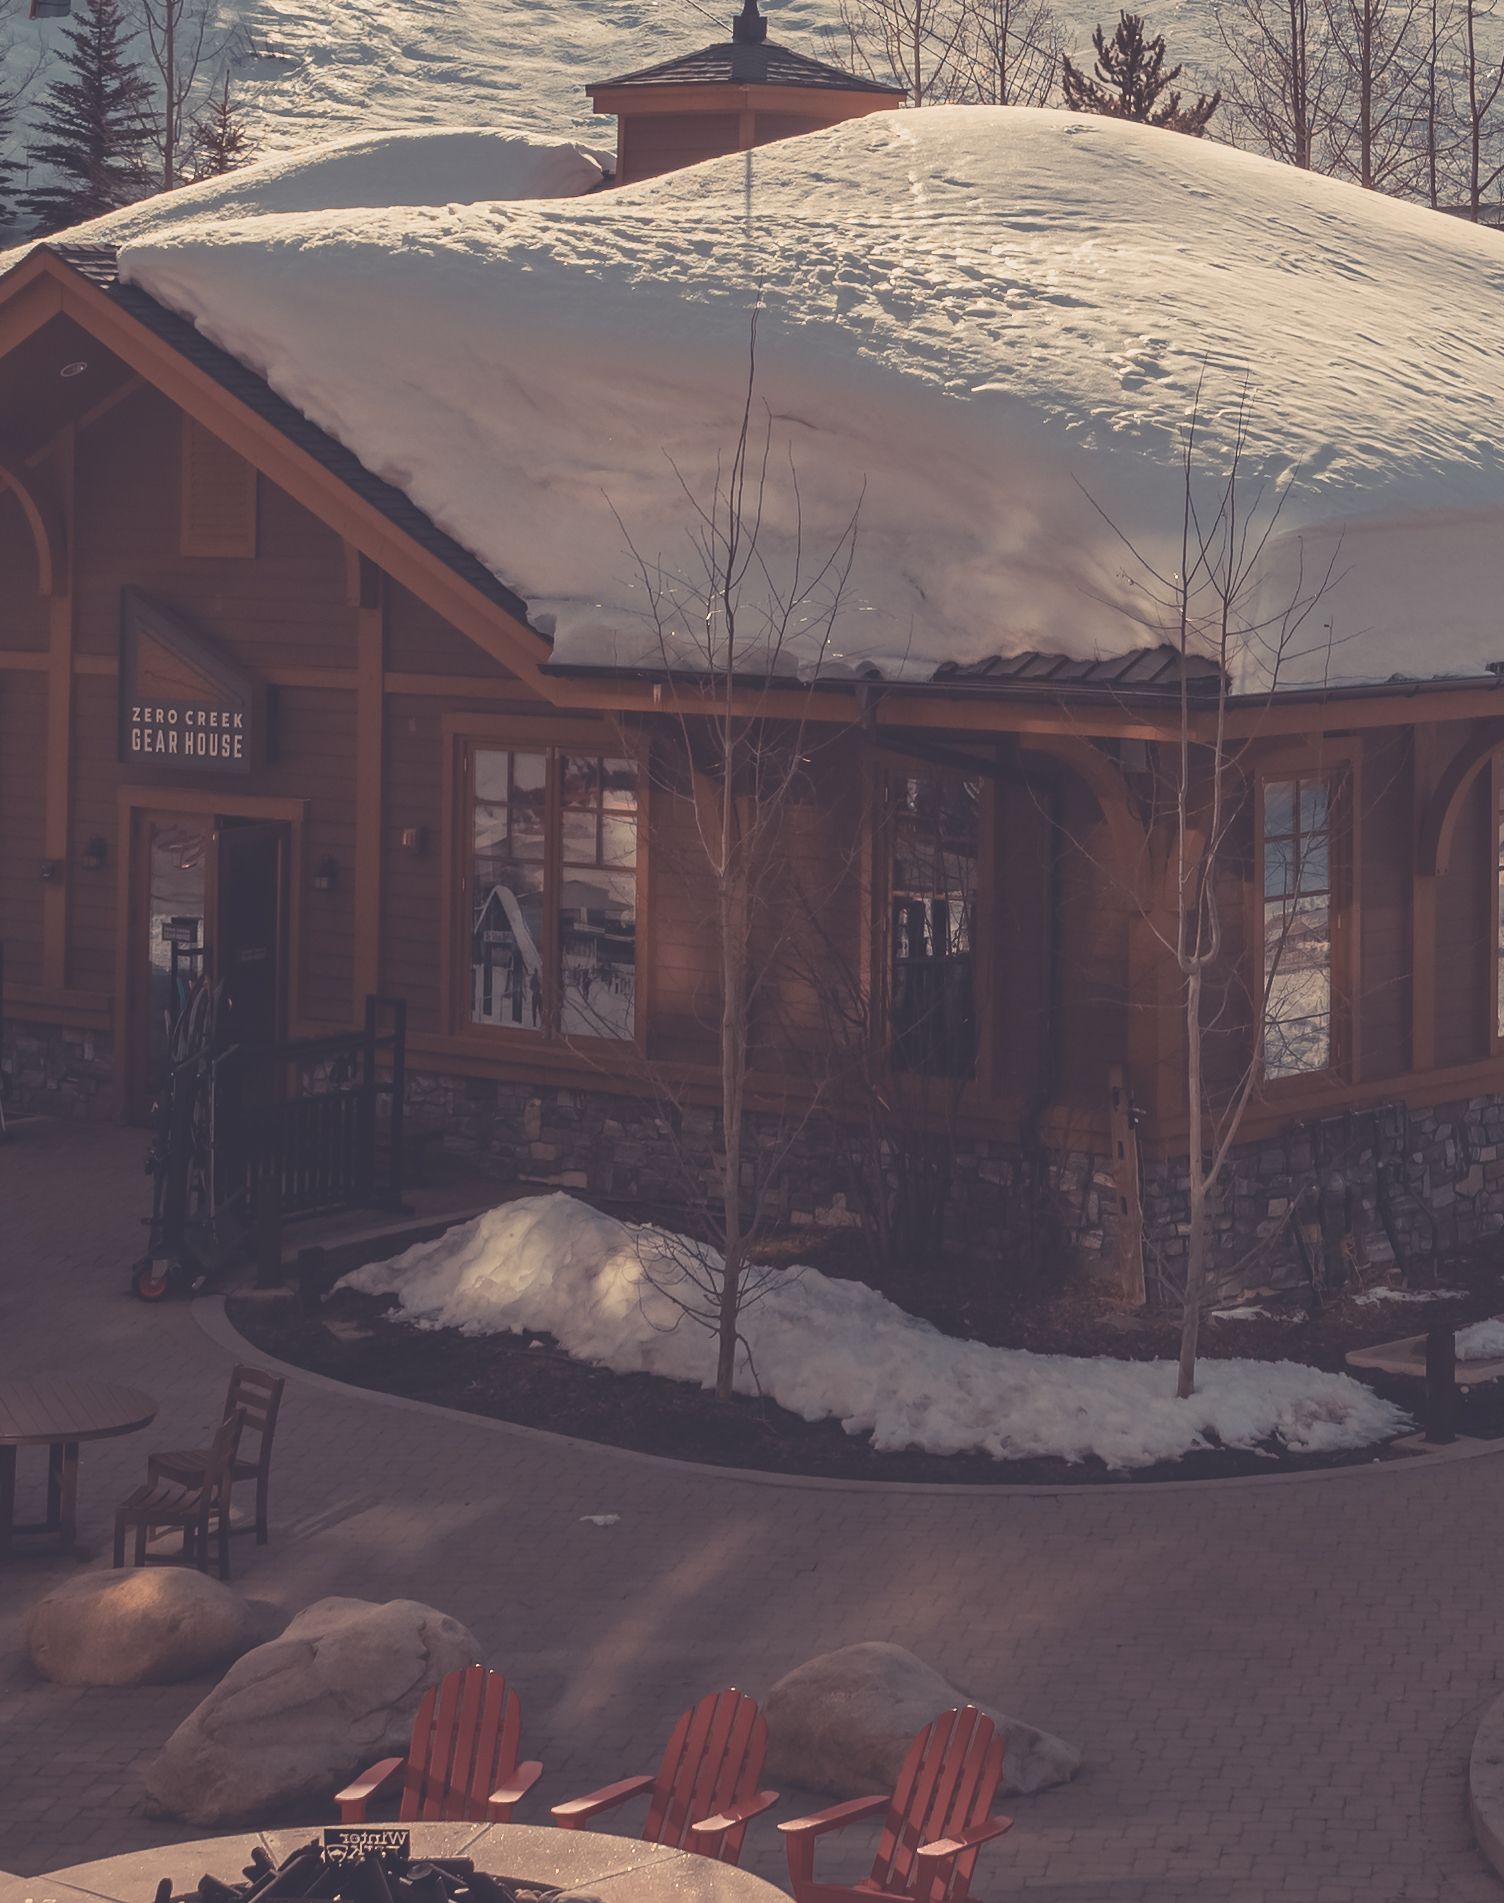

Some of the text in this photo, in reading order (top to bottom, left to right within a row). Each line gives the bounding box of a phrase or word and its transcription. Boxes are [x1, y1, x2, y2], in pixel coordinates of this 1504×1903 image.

[132, 707, 243, 728] ZERO CREEK
[132, 728, 243, 758] GEAR HOUSE
